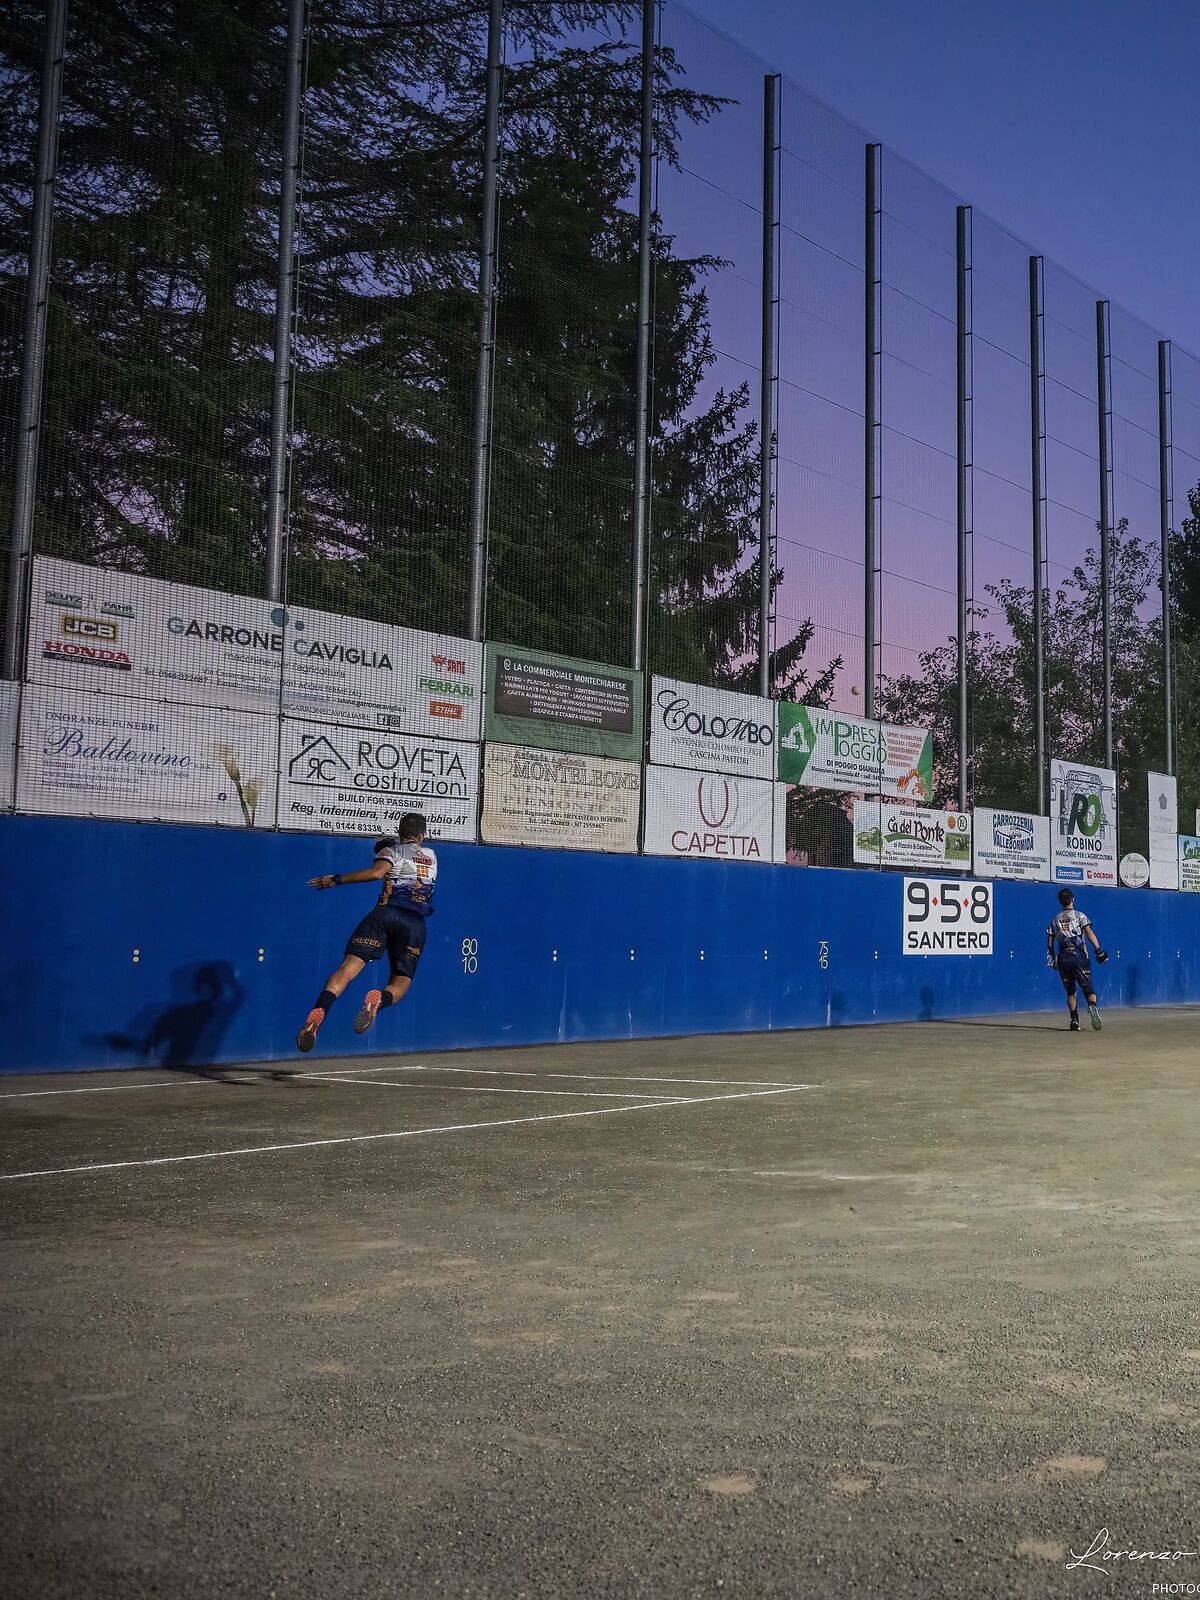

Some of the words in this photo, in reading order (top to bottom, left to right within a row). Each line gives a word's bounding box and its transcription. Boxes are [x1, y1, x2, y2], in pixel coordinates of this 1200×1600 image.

[65, 618, 115, 639] JCB
[43, 640, 130, 662] HONDA
[167, 616, 282, 651] GARRONE
[293, 639, 393, 671] CAVIGLIA
[513, 662, 523, 672] LA
[523, 663, 573, 682] COMMERCIALE
[573, 673, 627, 691] MONTECHIARESE
[419, 678, 474, 696] FERRARI
[45, 711, 109, 727] ONORANZE
[112, 719, 160, 732] FUNEBRI
[656, 689, 773, 746] COLOMBO
[43, 725, 193, 768] Baldovino
[358, 741, 466, 778] ROVETA
[689, 750, 721, 762] CASCINA
[722, 755, 750, 765] PASTORI
[513, 760, 639, 790] MONTELEONE
[835, 761, 857, 770] POGGIO
[858, 764, 885, 775] GIANLUCA
[353, 770, 467, 797] costruzioni
[512, 784, 555, 796] VINI
[338, 793, 365, 804] BUILD
[367, 796, 385, 805] FOR
[386, 798, 424, 808] PASSION
[290, 801, 317, 816] Reg.
[320, 804, 379, 821] Infermiera,
[384, 810, 407, 822] 1405
[424, 814, 452, 825] ubbio
[453, 815, 468, 826] AT
[563, 813, 598, 822] MONASTERO
[335, 822, 356, 831] 0144
[899, 818, 912, 834] del
[913, 820, 945, 843] Ponte
[992, 813, 1034, 833] CARROZZERIA
[671, 830, 761, 857] CAPETTA
[1066, 836, 1103, 852] ROBINO
[1055, 849, 1077, 858] MACCHINE
[1084, 852, 1113, 860] L'AGRICOLTURA
[1093, 871, 1114, 880] GOLDONI
[461, 938, 478, 956] 80
[818, 941, 829, 955] 75
[907, 931, 990, 949] SANTERO
[461, 956, 478, 974] 10
[818, 955, 829, 970] 15
